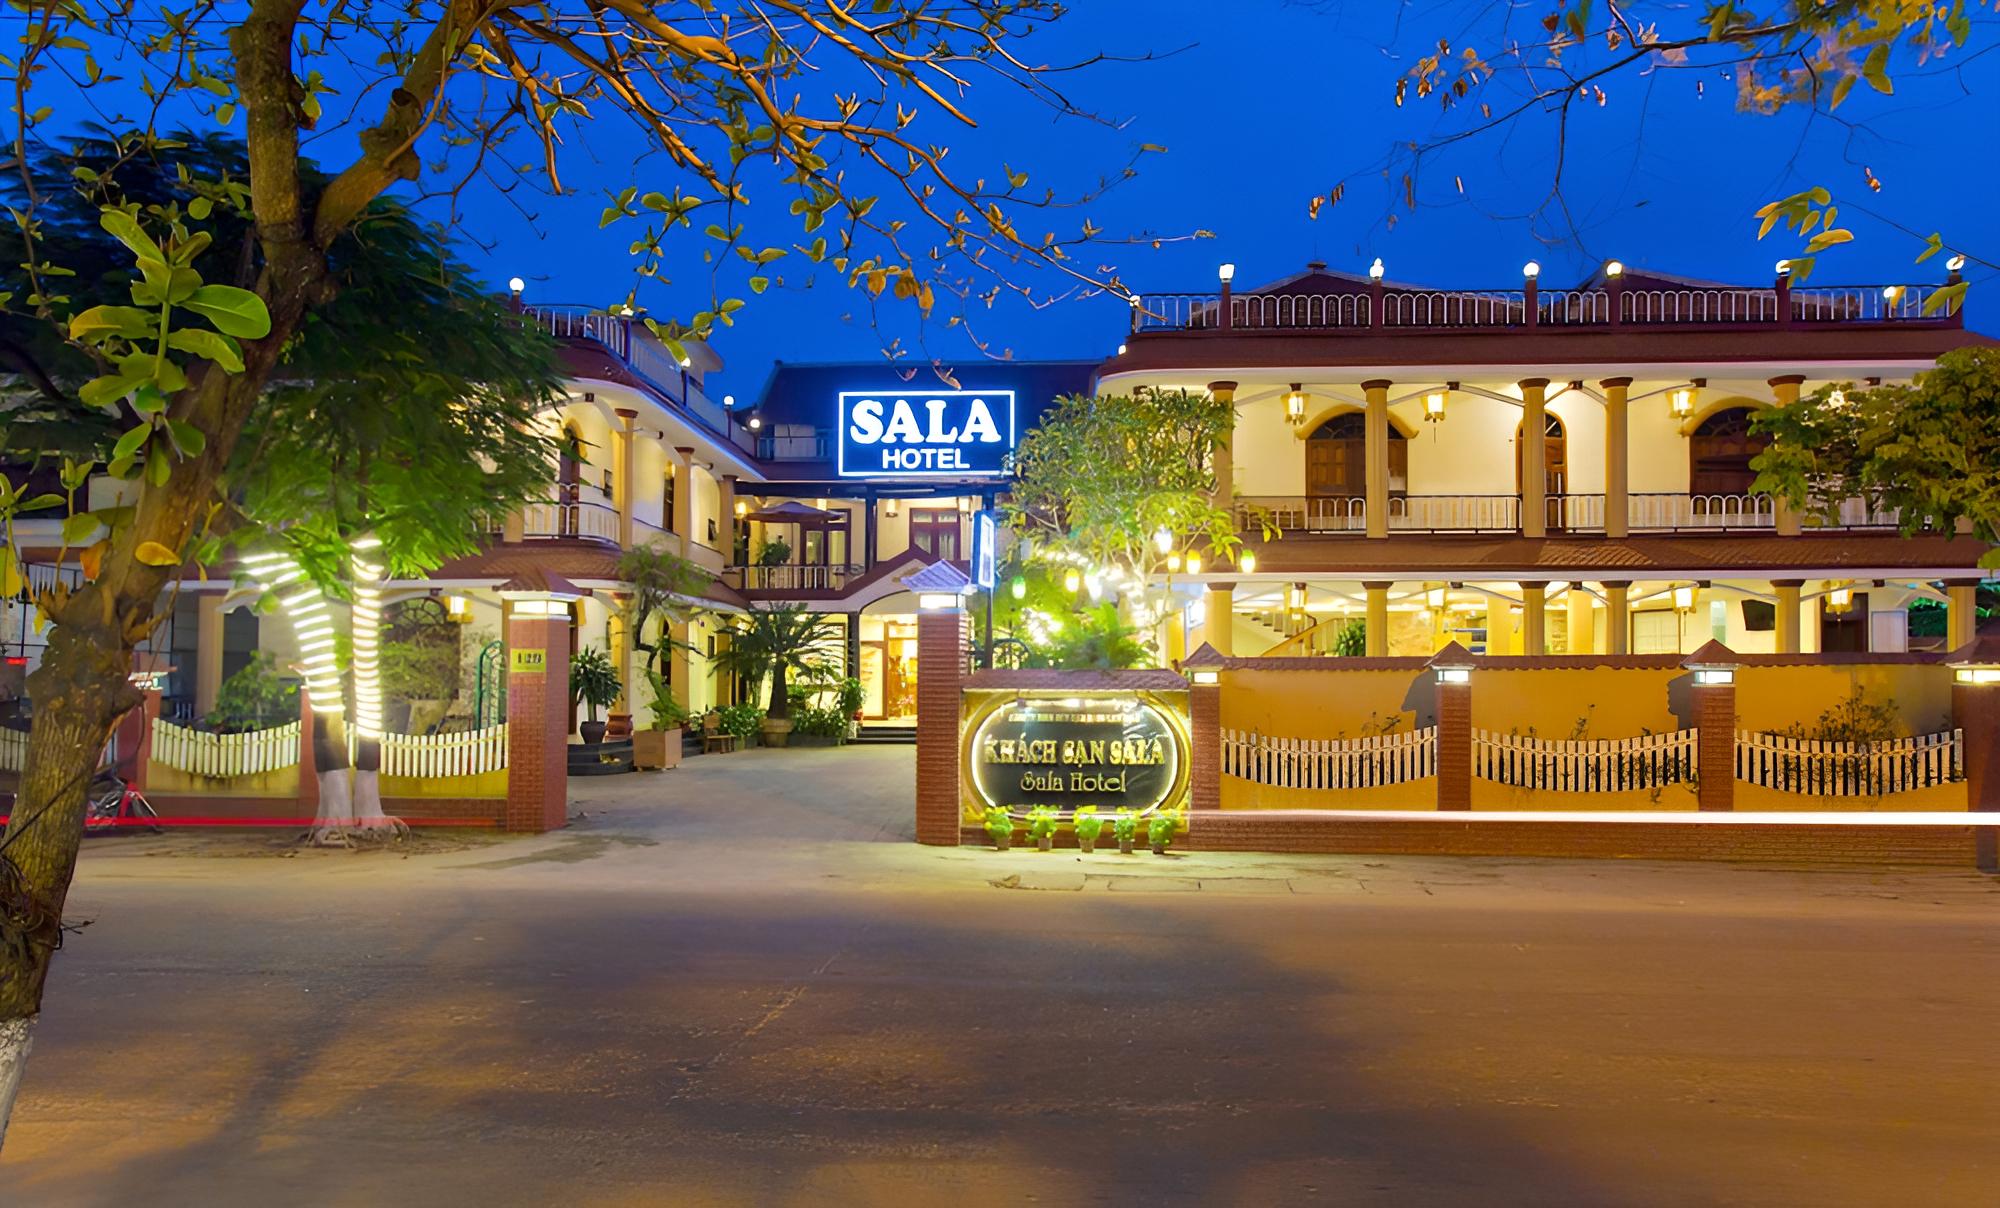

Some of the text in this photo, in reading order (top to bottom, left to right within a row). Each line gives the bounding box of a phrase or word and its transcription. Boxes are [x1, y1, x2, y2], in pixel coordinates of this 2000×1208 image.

[850, 399, 1001, 444] SALA
[882, 448, 970, 469] HOTEL
[984, 732, 1057, 764] KHÁCH
[1109, 740, 1166, 765] SALA
[1020, 771, 1127, 792] Sala Hotel
